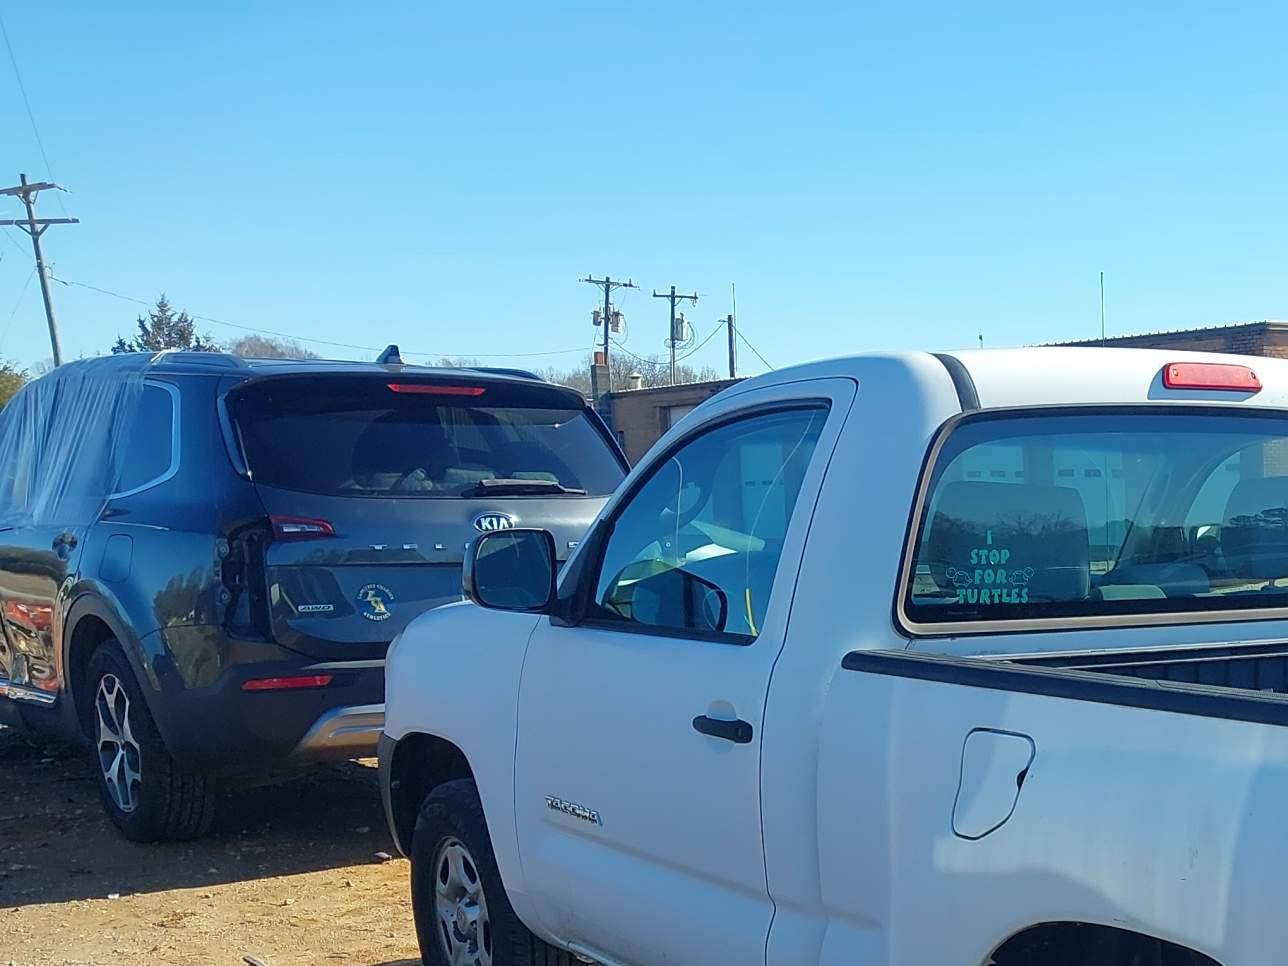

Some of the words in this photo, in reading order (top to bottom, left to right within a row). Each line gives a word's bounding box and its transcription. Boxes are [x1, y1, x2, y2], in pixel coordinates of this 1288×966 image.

[479, 517, 509, 530] KIA
[986, 529, 993, 545] I
[970, 548, 1010, 565] STOP
[974, 568, 1008, 585] FOR
[955, 587, 1029, 605] TURTLES
